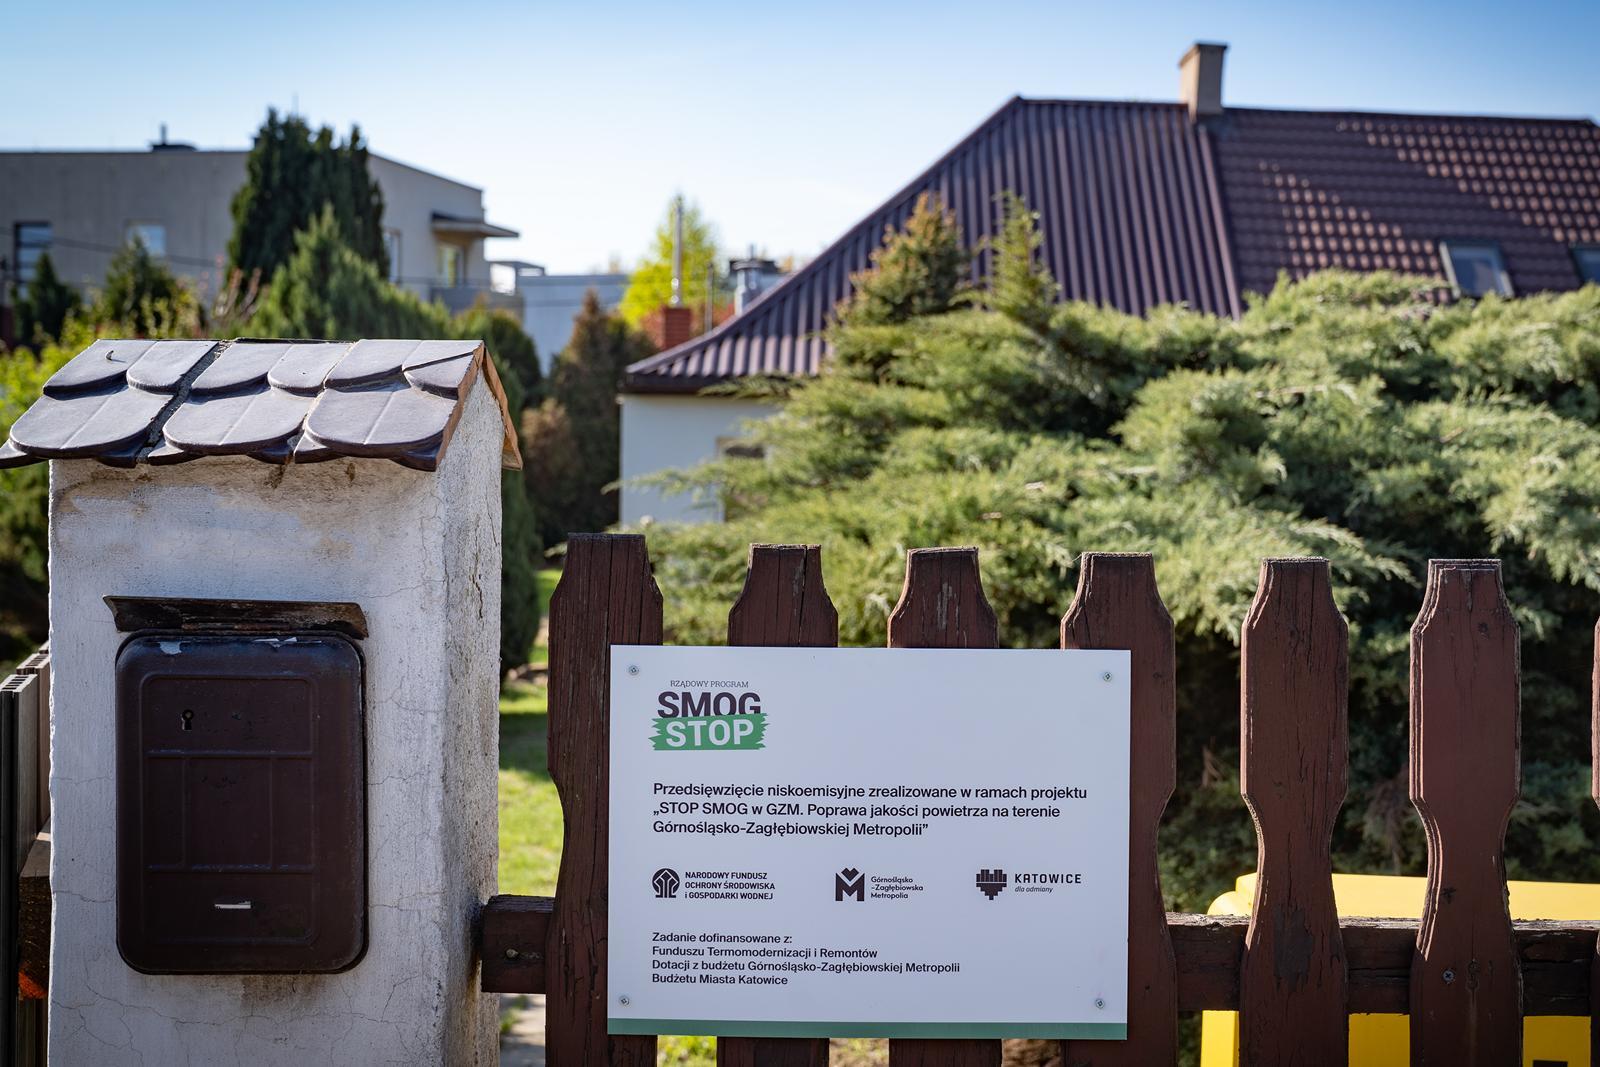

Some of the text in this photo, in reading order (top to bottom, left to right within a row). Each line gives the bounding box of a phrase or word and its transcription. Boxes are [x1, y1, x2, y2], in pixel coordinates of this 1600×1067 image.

[670, 680, 709, 688] RZĄDOWY
[658, 691, 761, 718] SMOG
[666, 719, 754, 747] STOP
[653, 782, 1087, 801] Przedsięwzięcie niskoemisyjne zrealizowane w ramach projektu
[702, 802, 748, 815] SMOG
[751, 806, 763, 815] w
[766, 803, 804, 815] GZM.
[807, 803, 867, 818] Poprawa
[869, 804, 918, 819] jakości
[922, 805, 988, 819] powietrza
[992, 807, 1009, 817] na
[1012, 805, 1060, 818] terenie
[653, 820, 928, 838] Górnośląsko-Zagłębiowskiej Metropolii”
[685, 871, 768, 880] NARODOWY FUNDUSZ
[870, 876, 913, 885] Górnośląsko
[1014, 873, 1082, 884] KATOWICE
[685, 880, 776, 890] OCHRONY ŚRODOWISKA
[1025, 886, 1053, 894] odmiany
[684, 891, 773, 900] i GOSPODARKI WODNEJ
[870, 892, 908, 900] Metropolia
[652, 932, 792, 944] Zadanie dofinansowane z:
[652, 946, 878, 960] Funduszu Termomodernizacji i Remontów
[652, 959, 960, 974] Dotacji z budżetu Górnośląsko-Zagłębiowskiej Metropolii
[652, 973, 788, 985] Budżetu Miasta Katowice
